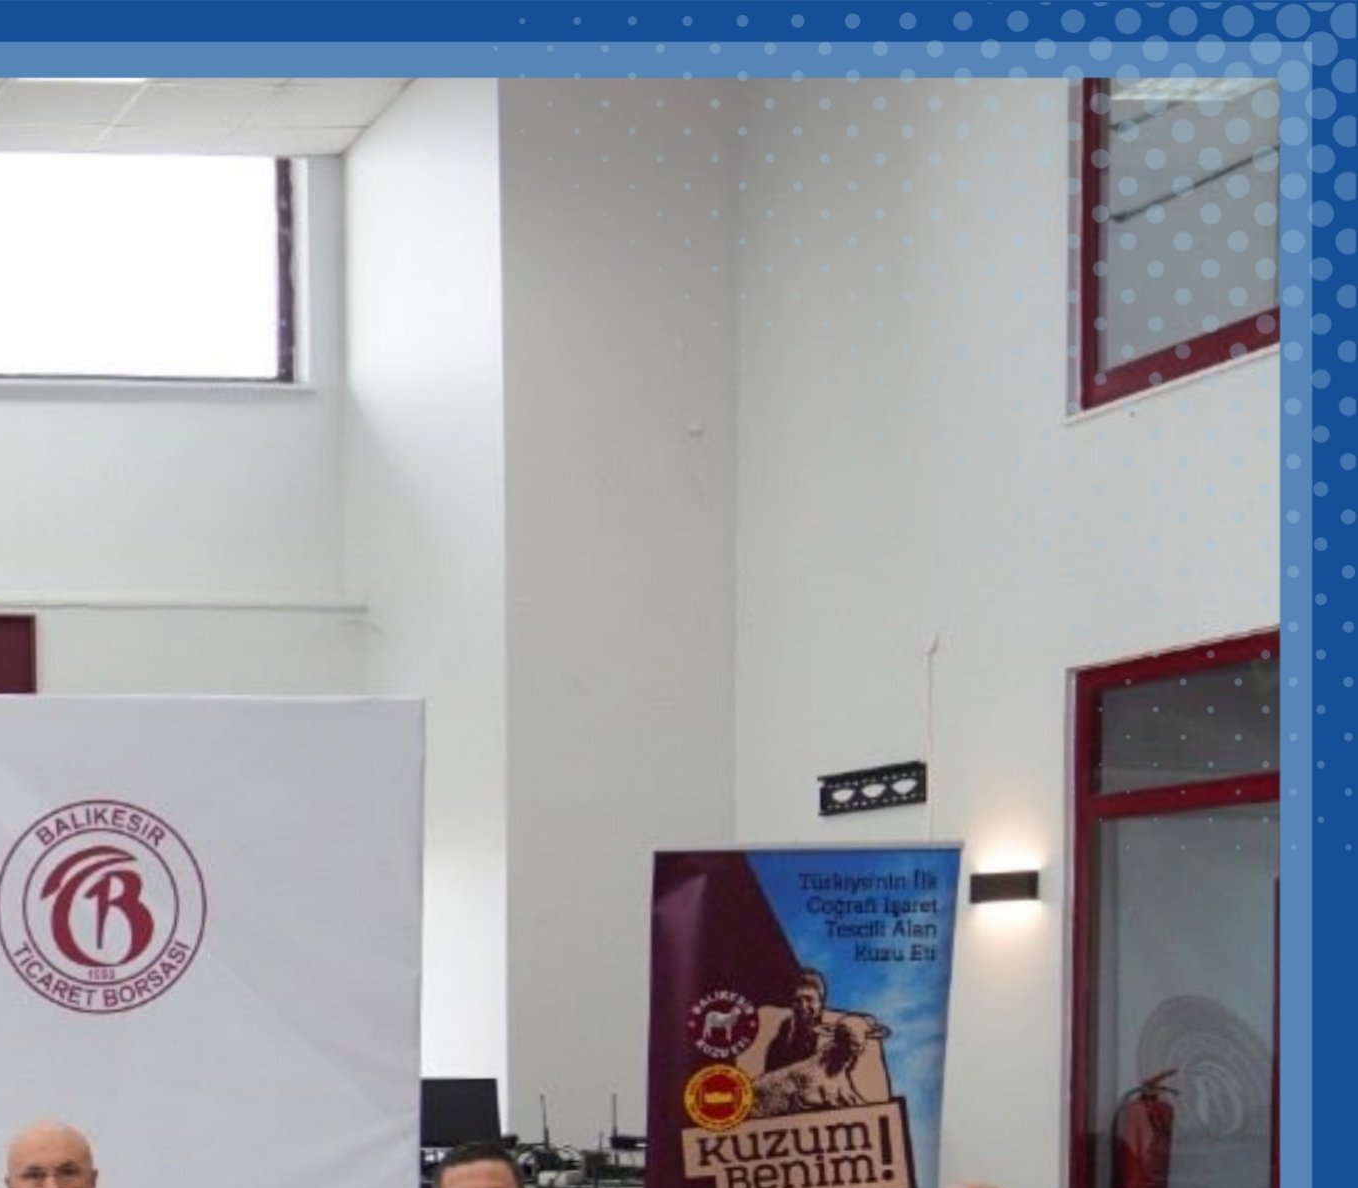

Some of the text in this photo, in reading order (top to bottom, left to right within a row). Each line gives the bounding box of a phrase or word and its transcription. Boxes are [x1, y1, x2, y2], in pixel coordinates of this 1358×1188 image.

[35, 807, 167, 847] BALIKESİR
[892, 919, 937, 937] Alan
[853, 943, 904, 962] Kuzu
[13, 940, 192, 1008] TİCARET BORSASI
[697, 1117, 873, 1167] Kuzum
